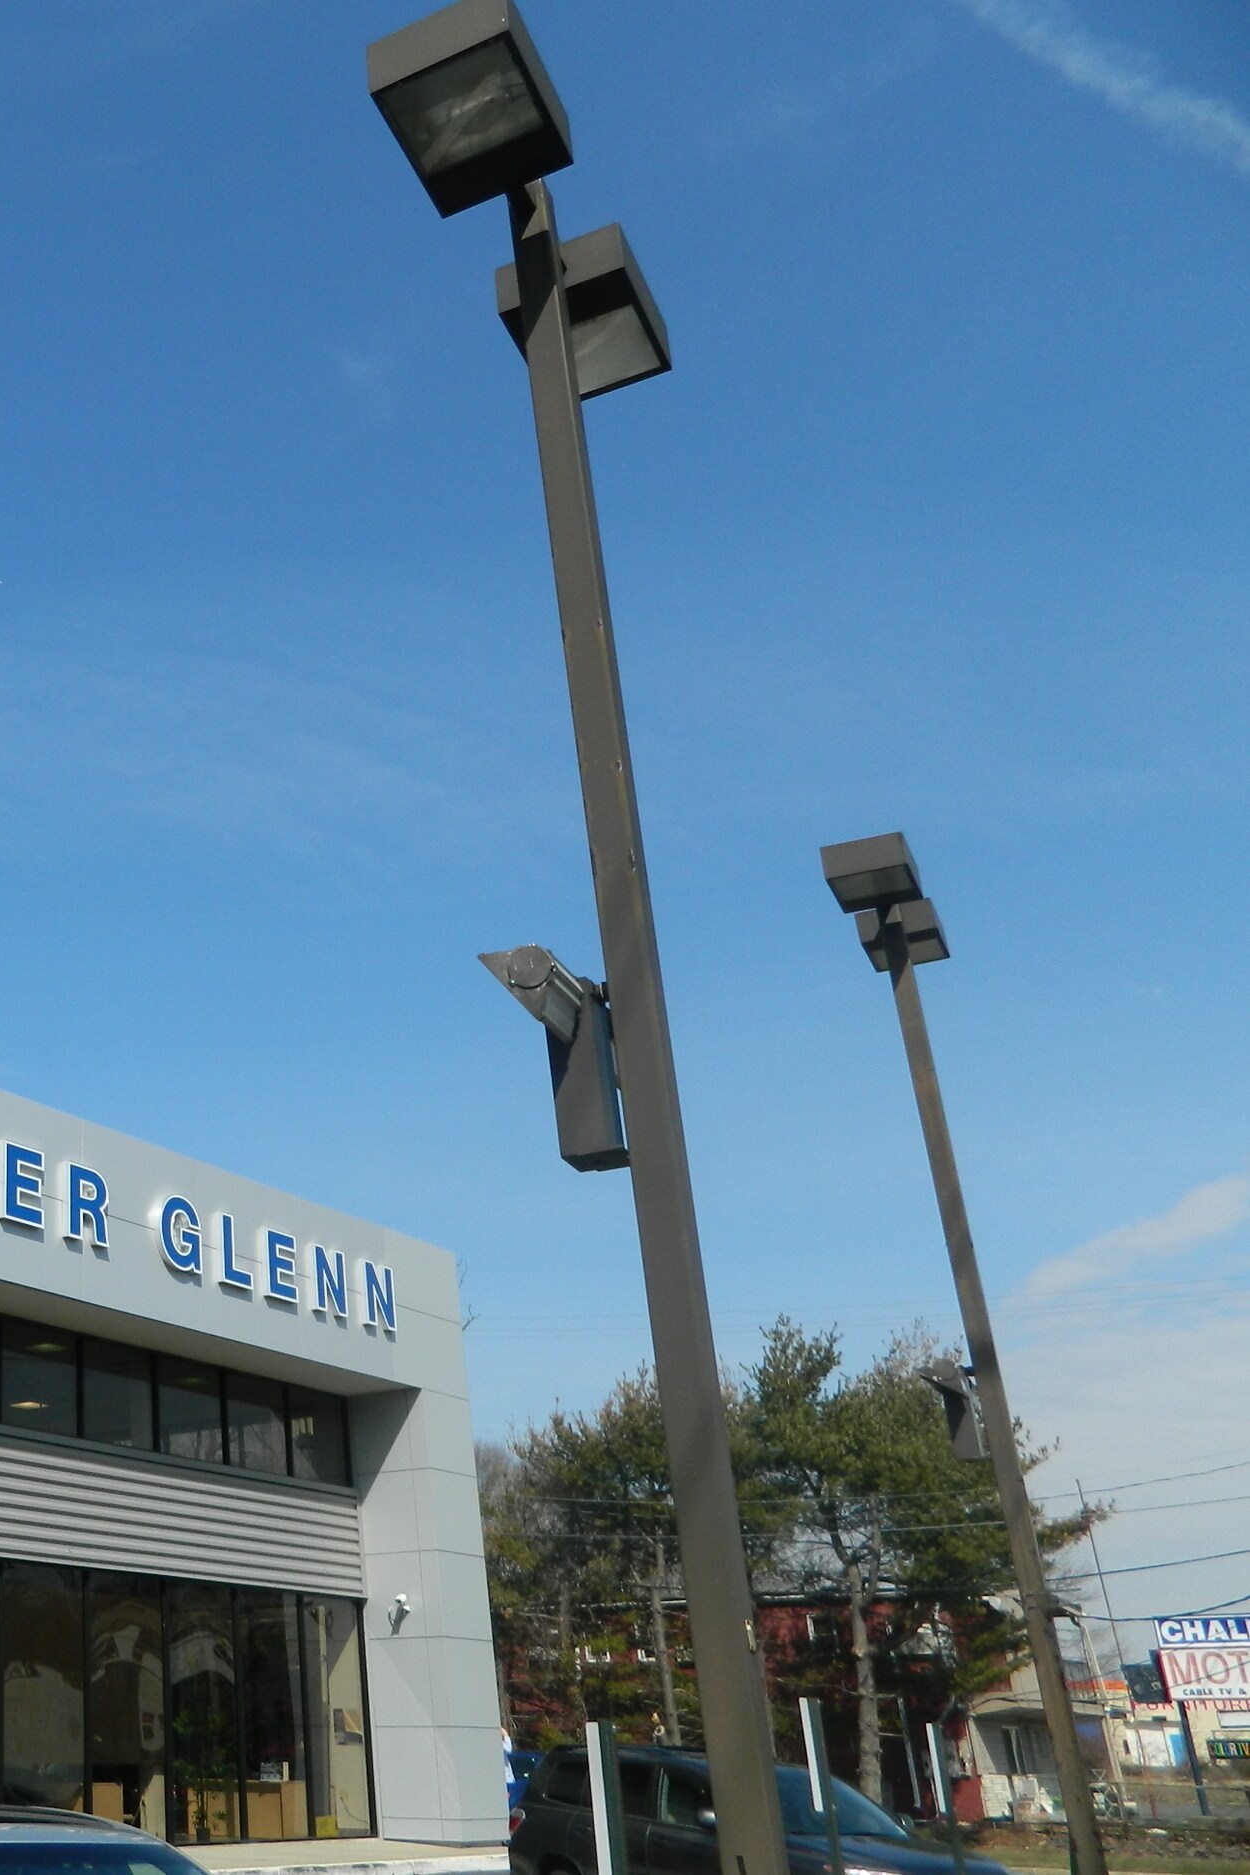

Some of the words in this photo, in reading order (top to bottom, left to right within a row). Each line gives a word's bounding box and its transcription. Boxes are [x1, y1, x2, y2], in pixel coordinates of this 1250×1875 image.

[157, 1194, 398, 1333] GLENN
[1183, 1687, 1214, 1696] CABLE
[1219, 1687, 1232, 1695] TV
